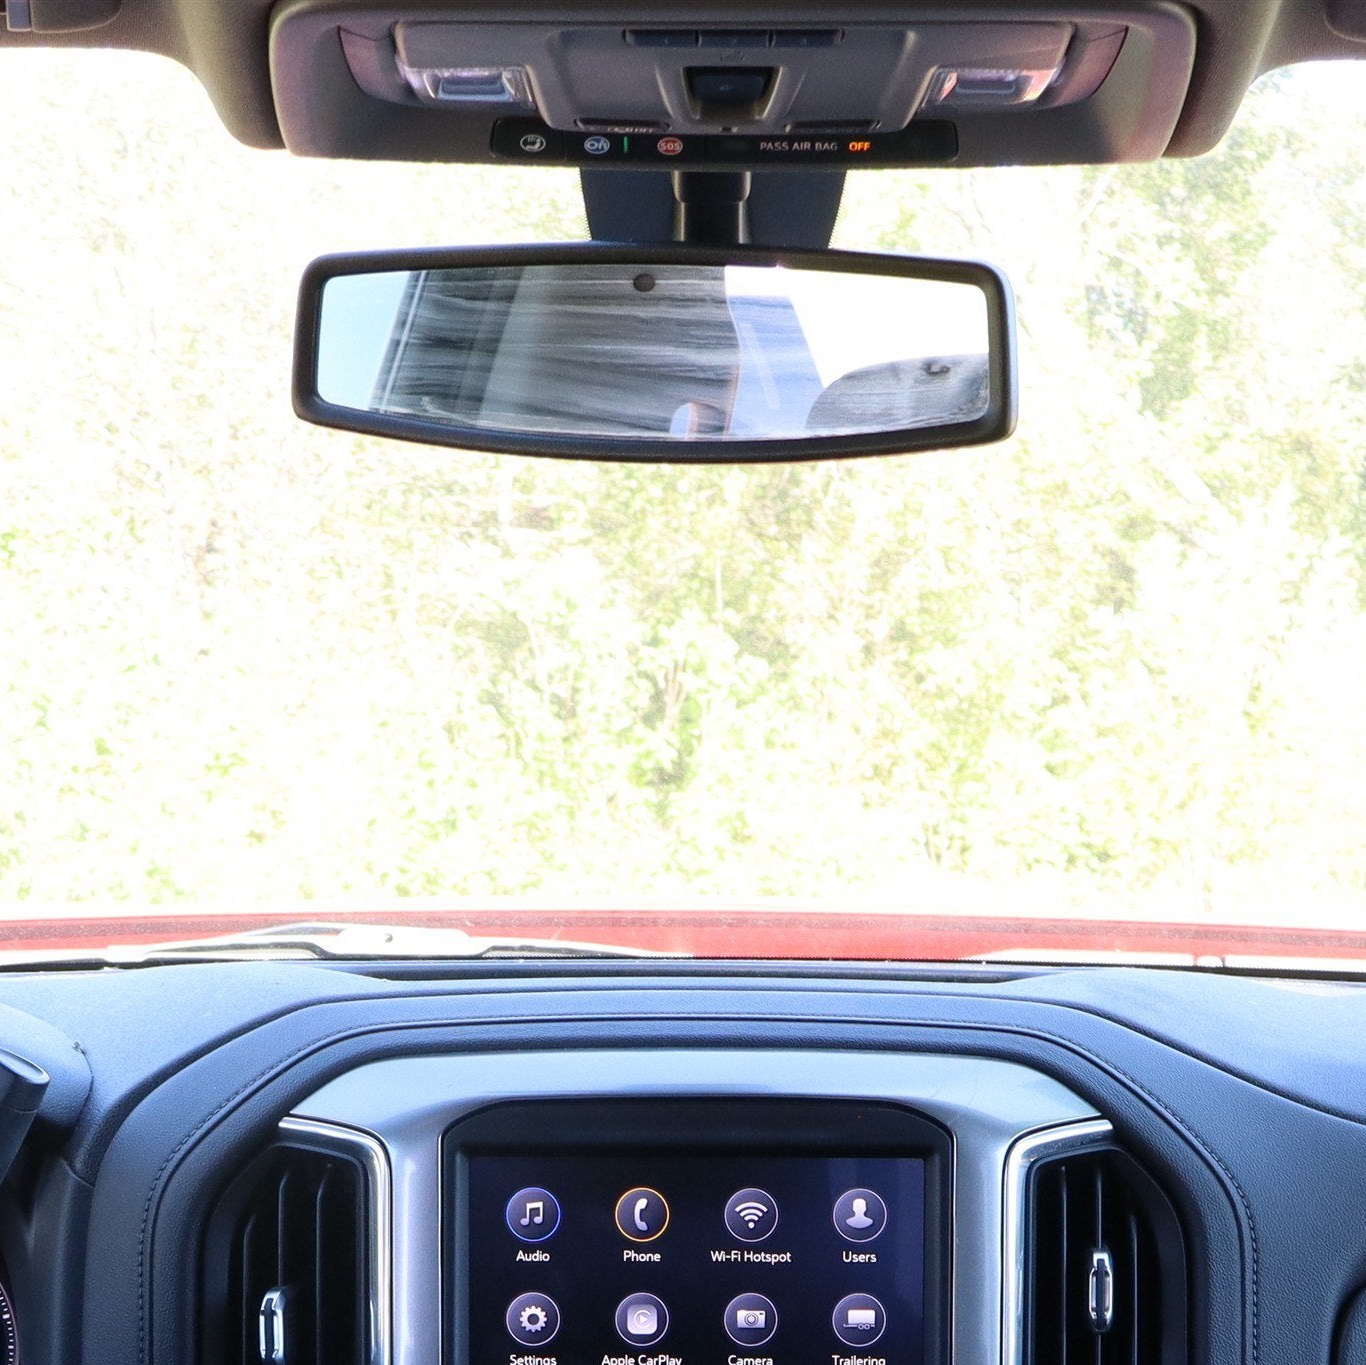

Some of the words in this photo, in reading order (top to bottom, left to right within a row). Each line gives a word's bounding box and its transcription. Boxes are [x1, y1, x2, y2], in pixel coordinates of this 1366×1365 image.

[659, 142, 681, 153] SOS
[759, 141, 789, 151] PASS
[792, 141, 812, 151] AIR
[814, 141, 838, 151] BAG
[848, 141, 872, 151] OFF
[515, 1249, 551, 1262] Audio
[623, 1249, 661, 1262] Phone
[710, 1250, 741, 1262] Wi-Fi
[743, 1250, 792, 1266] Hotspot
[842, 1250, 877, 1263] Users
